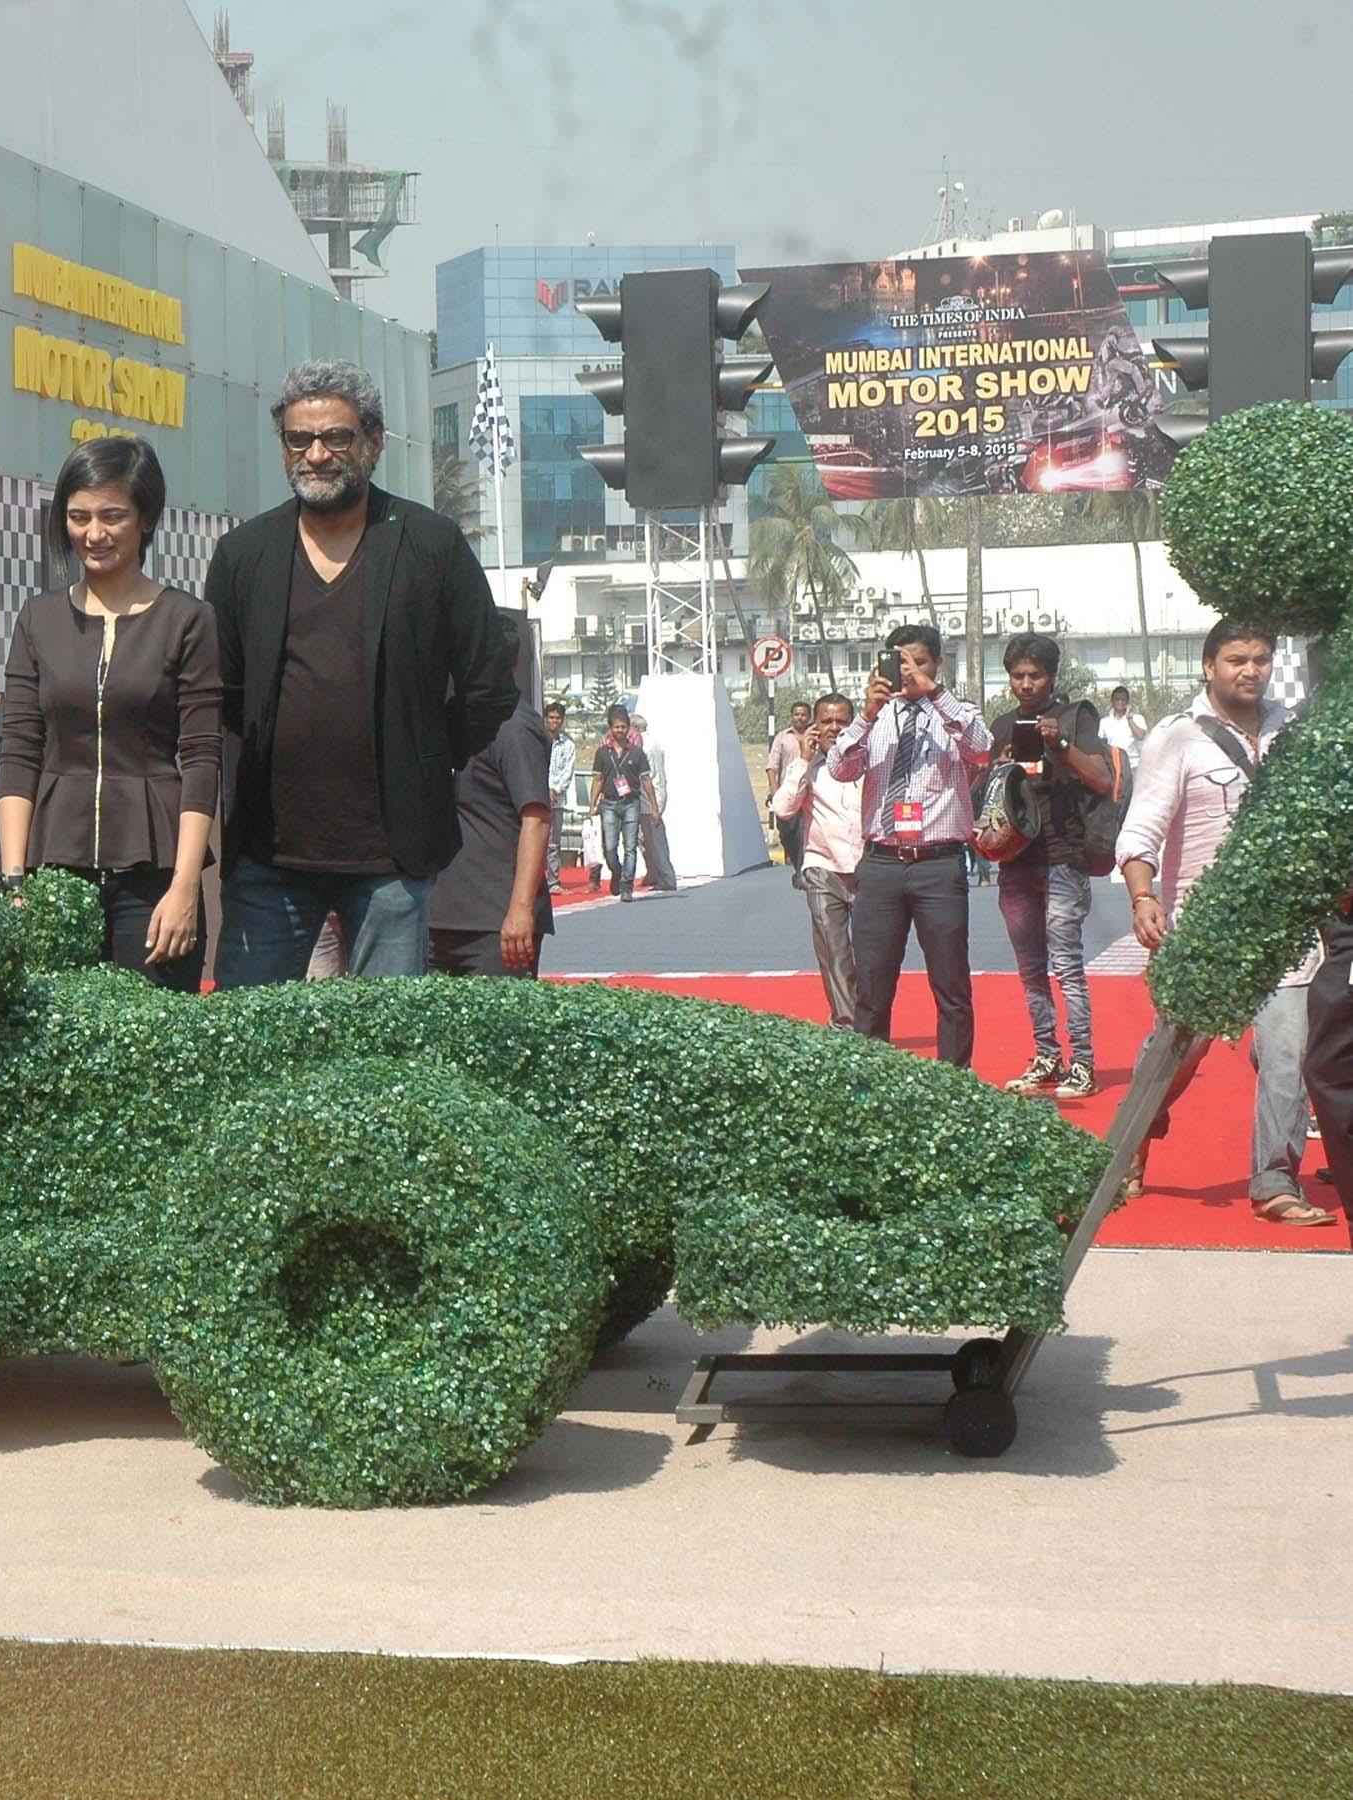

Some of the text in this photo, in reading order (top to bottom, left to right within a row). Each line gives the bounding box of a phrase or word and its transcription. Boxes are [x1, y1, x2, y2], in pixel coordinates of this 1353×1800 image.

[889, 307, 1026, 328] THE TIMES OF INDIA
[937, 329, 978, 339] PRESENTS
[825, 336, 1094, 375] MUMBAI INTERNATIONAL
[14, 324, 186, 430] MOTOR SHOW
[827, 365, 1092, 409] MOTOR SHOW
[913, 405, 1006, 439] 2015
[903, 443, 1016, 461] February 5-8, 2015
